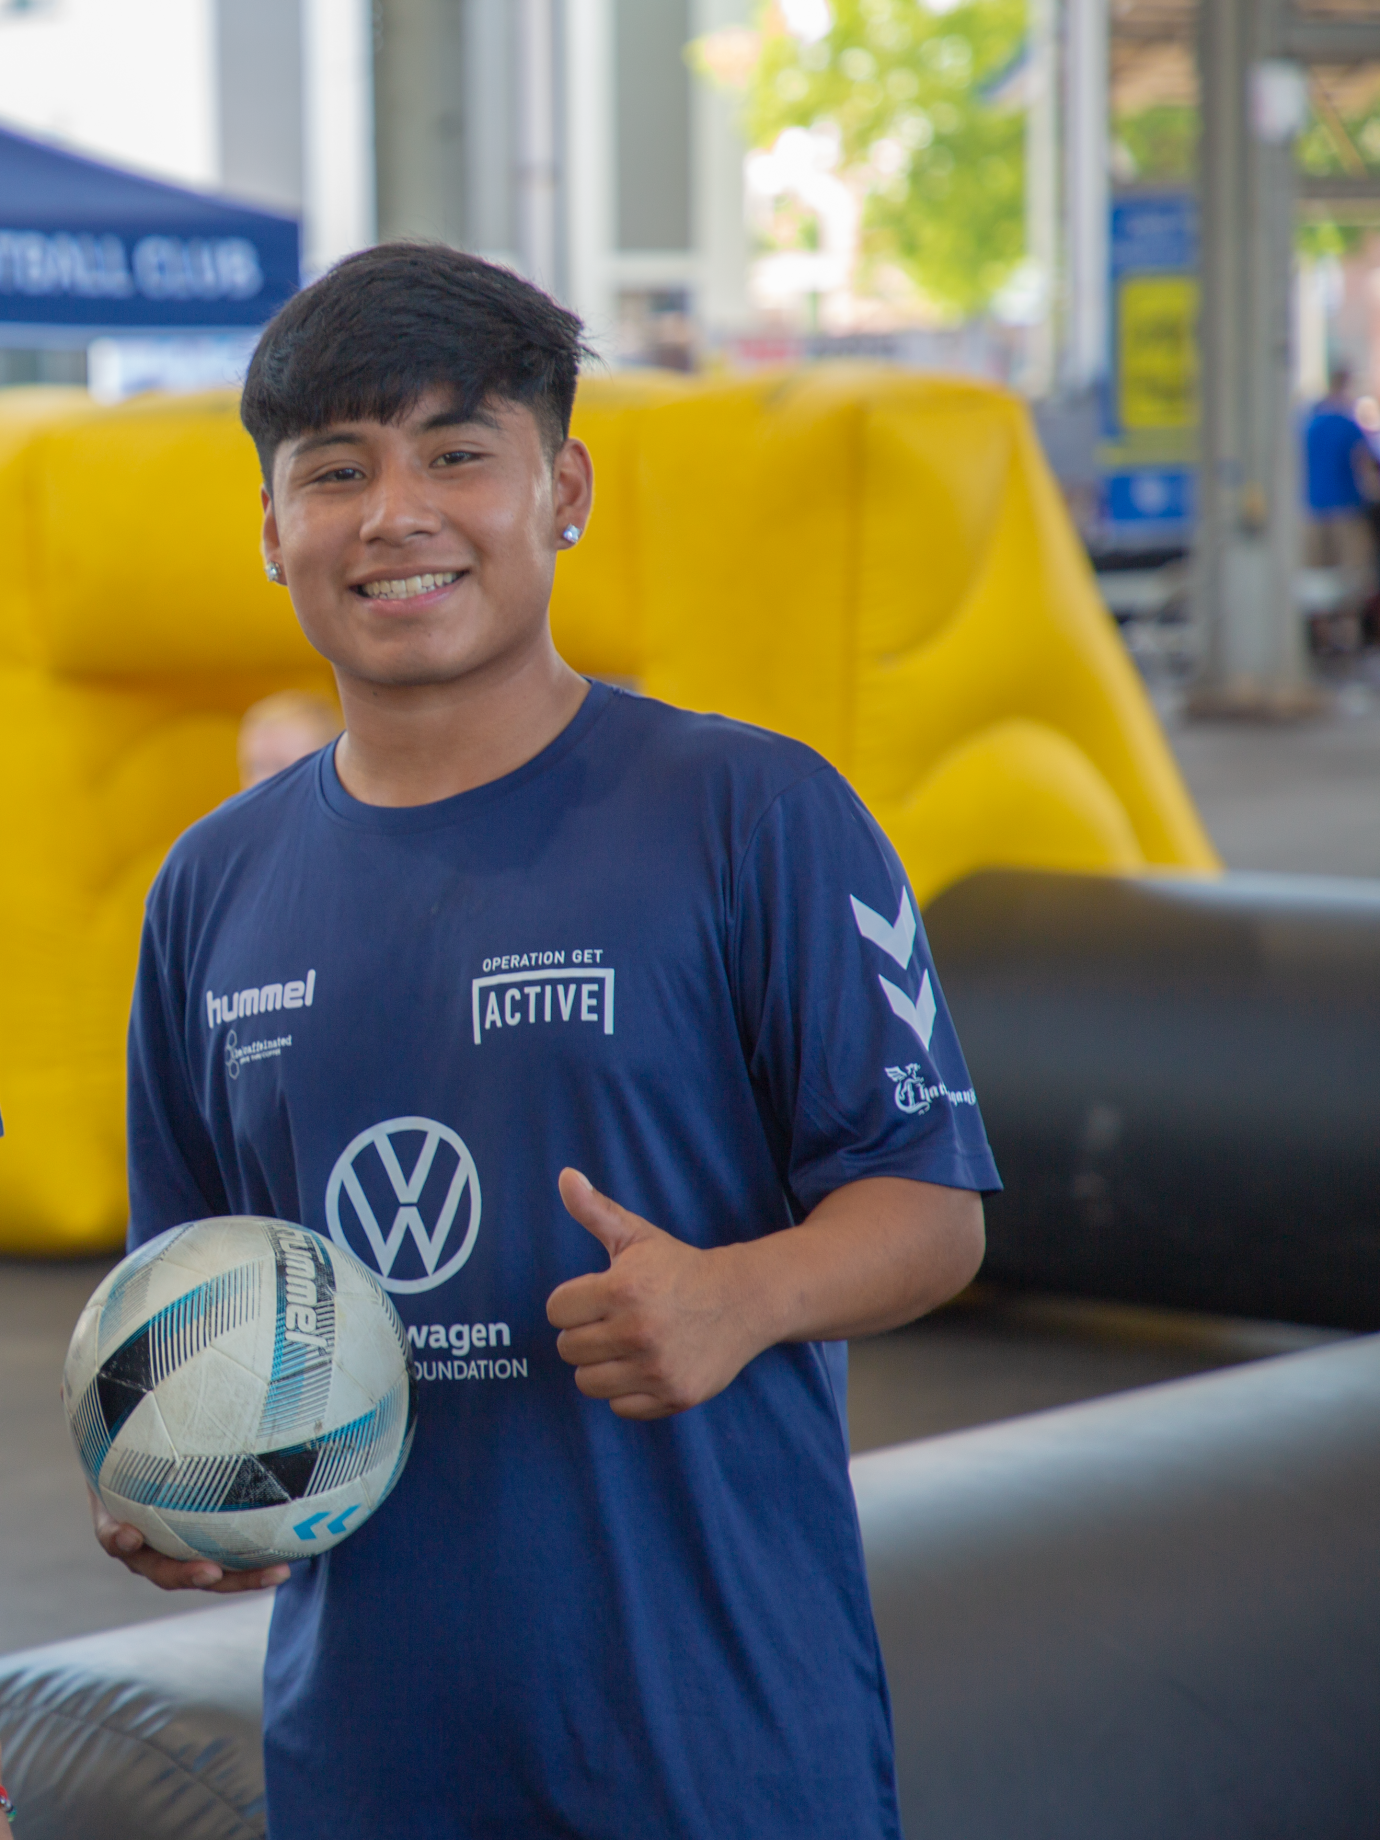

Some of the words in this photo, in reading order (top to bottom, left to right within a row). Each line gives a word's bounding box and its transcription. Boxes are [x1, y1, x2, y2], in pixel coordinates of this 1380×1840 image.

[133, 236, 263, 298] CLUB
[482, 949, 565, 972] OPERATION
[572, 949, 604, 963] GET
[206, 968, 317, 1029] hummel
[485, 983, 599, 1030] ACTIVE
[273, 1224, 328, 1348] hummel
[413, 1357, 528, 1381] OUNDATION
